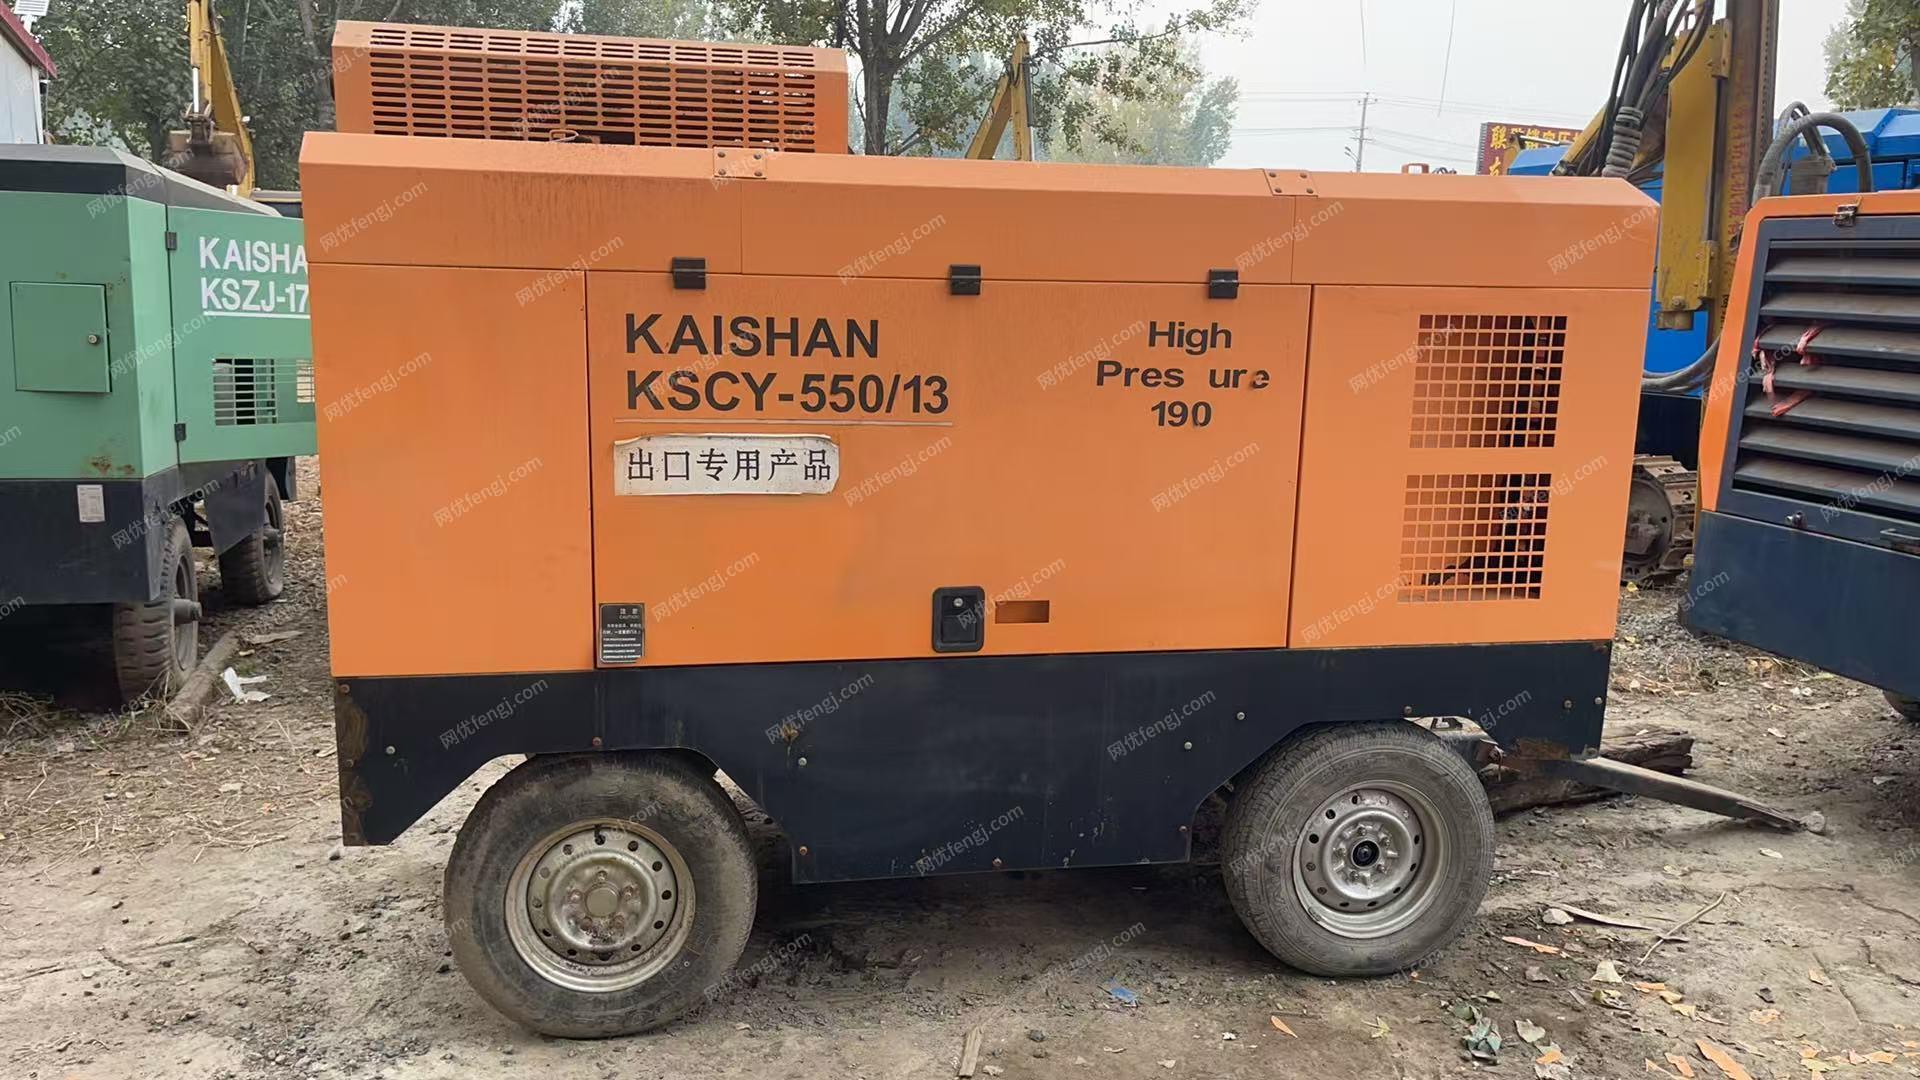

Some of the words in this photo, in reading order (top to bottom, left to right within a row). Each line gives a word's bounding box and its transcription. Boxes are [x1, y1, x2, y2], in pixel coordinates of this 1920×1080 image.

[200, 236, 309, 274] KAISHA
[201, 277, 309, 313] KSZJ-17
[625, 313, 879, 358] KAISHAN
[1148, 321, 1232, 355] High
[626, 370, 949, 414] KSCY-550/13
[1151, 400, 1212, 428] 190
[626, 447, 832, 482] 出口专用产品
